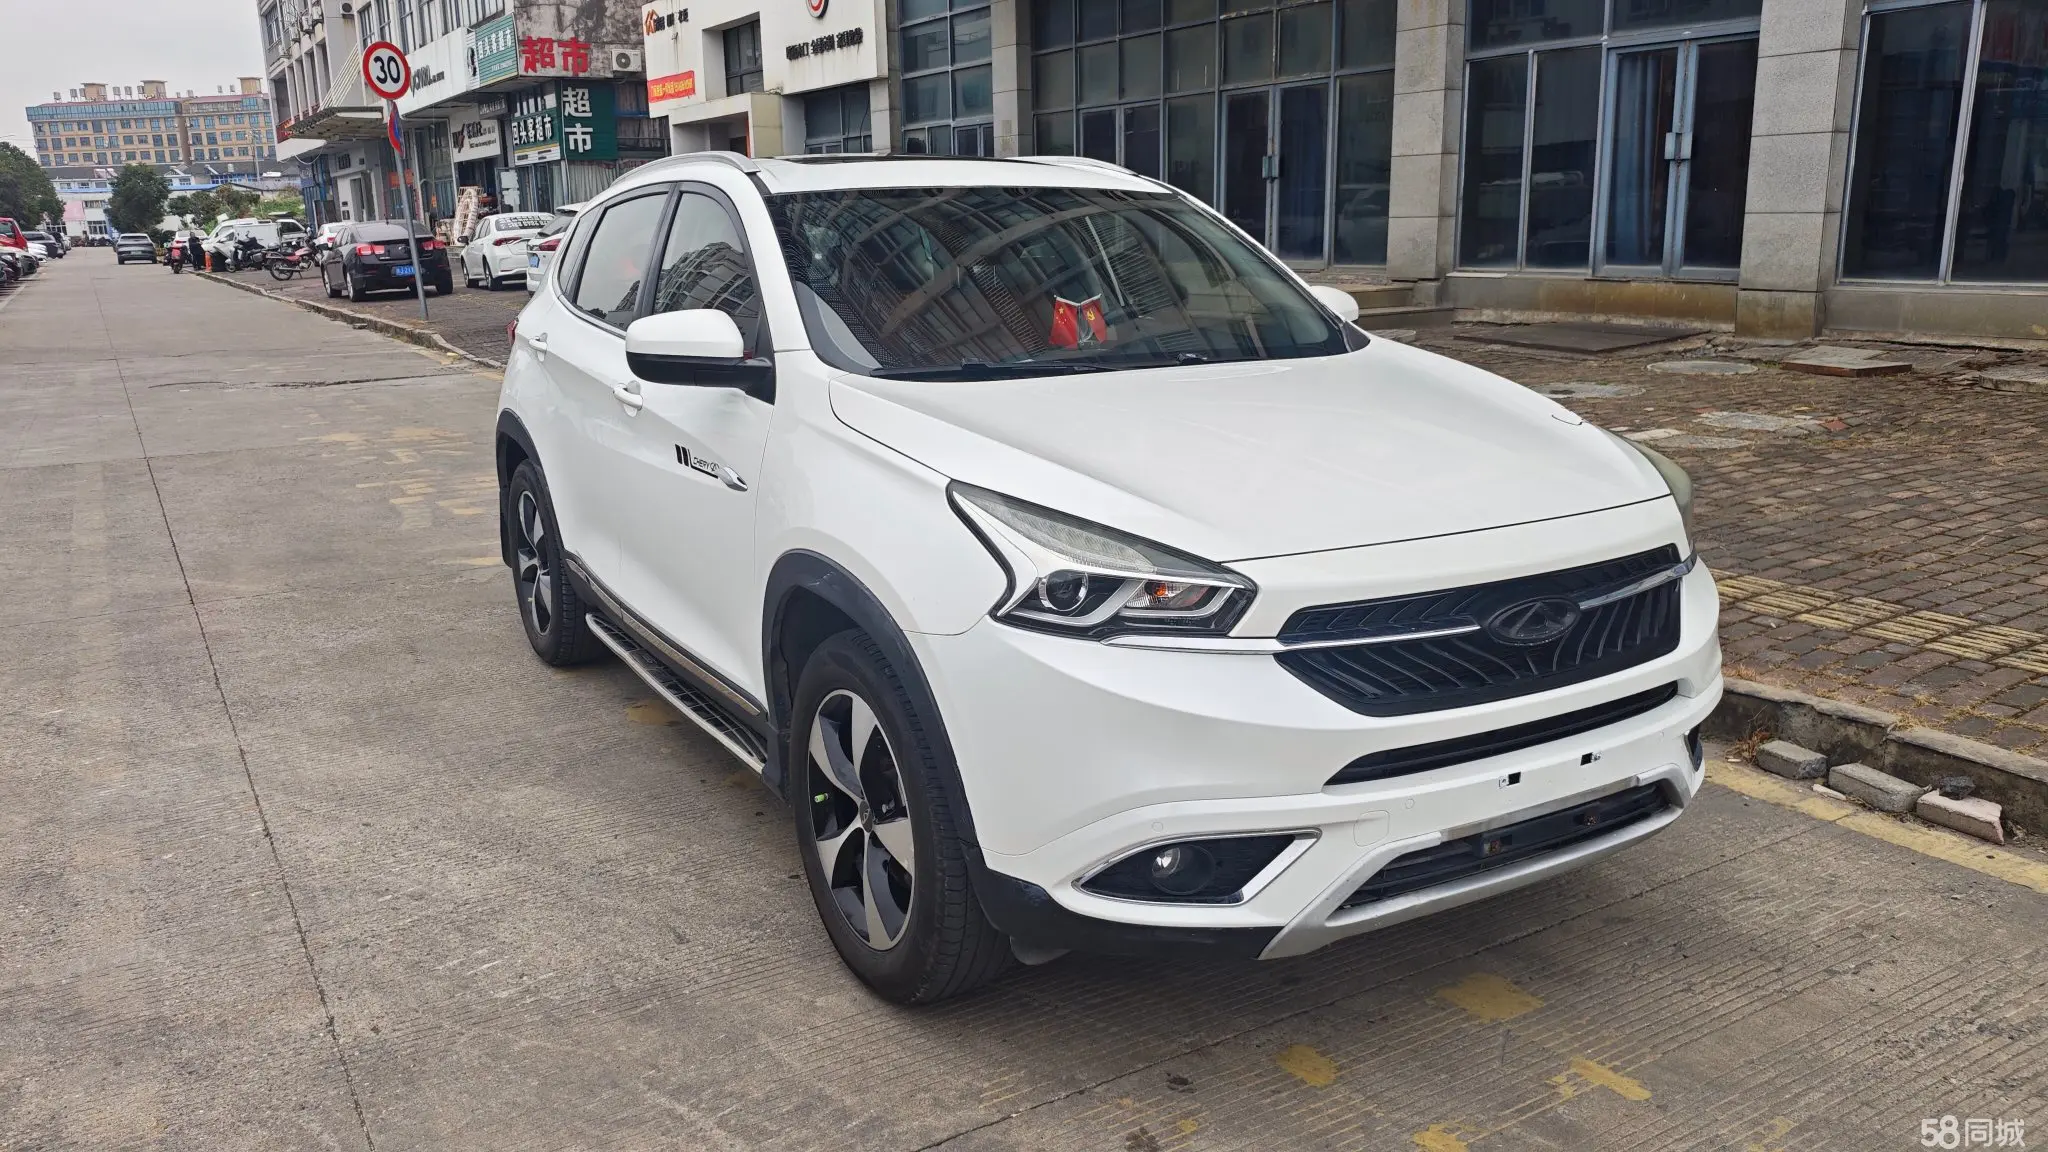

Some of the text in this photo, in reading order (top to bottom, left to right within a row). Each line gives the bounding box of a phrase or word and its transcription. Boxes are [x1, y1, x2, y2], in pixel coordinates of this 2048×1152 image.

[373, 55, 401, 84] 30
[521, 35, 592, 77] 超市
[512, 114, 553, 146] 回头客超市
[562, 86, 593, 153] 超市
